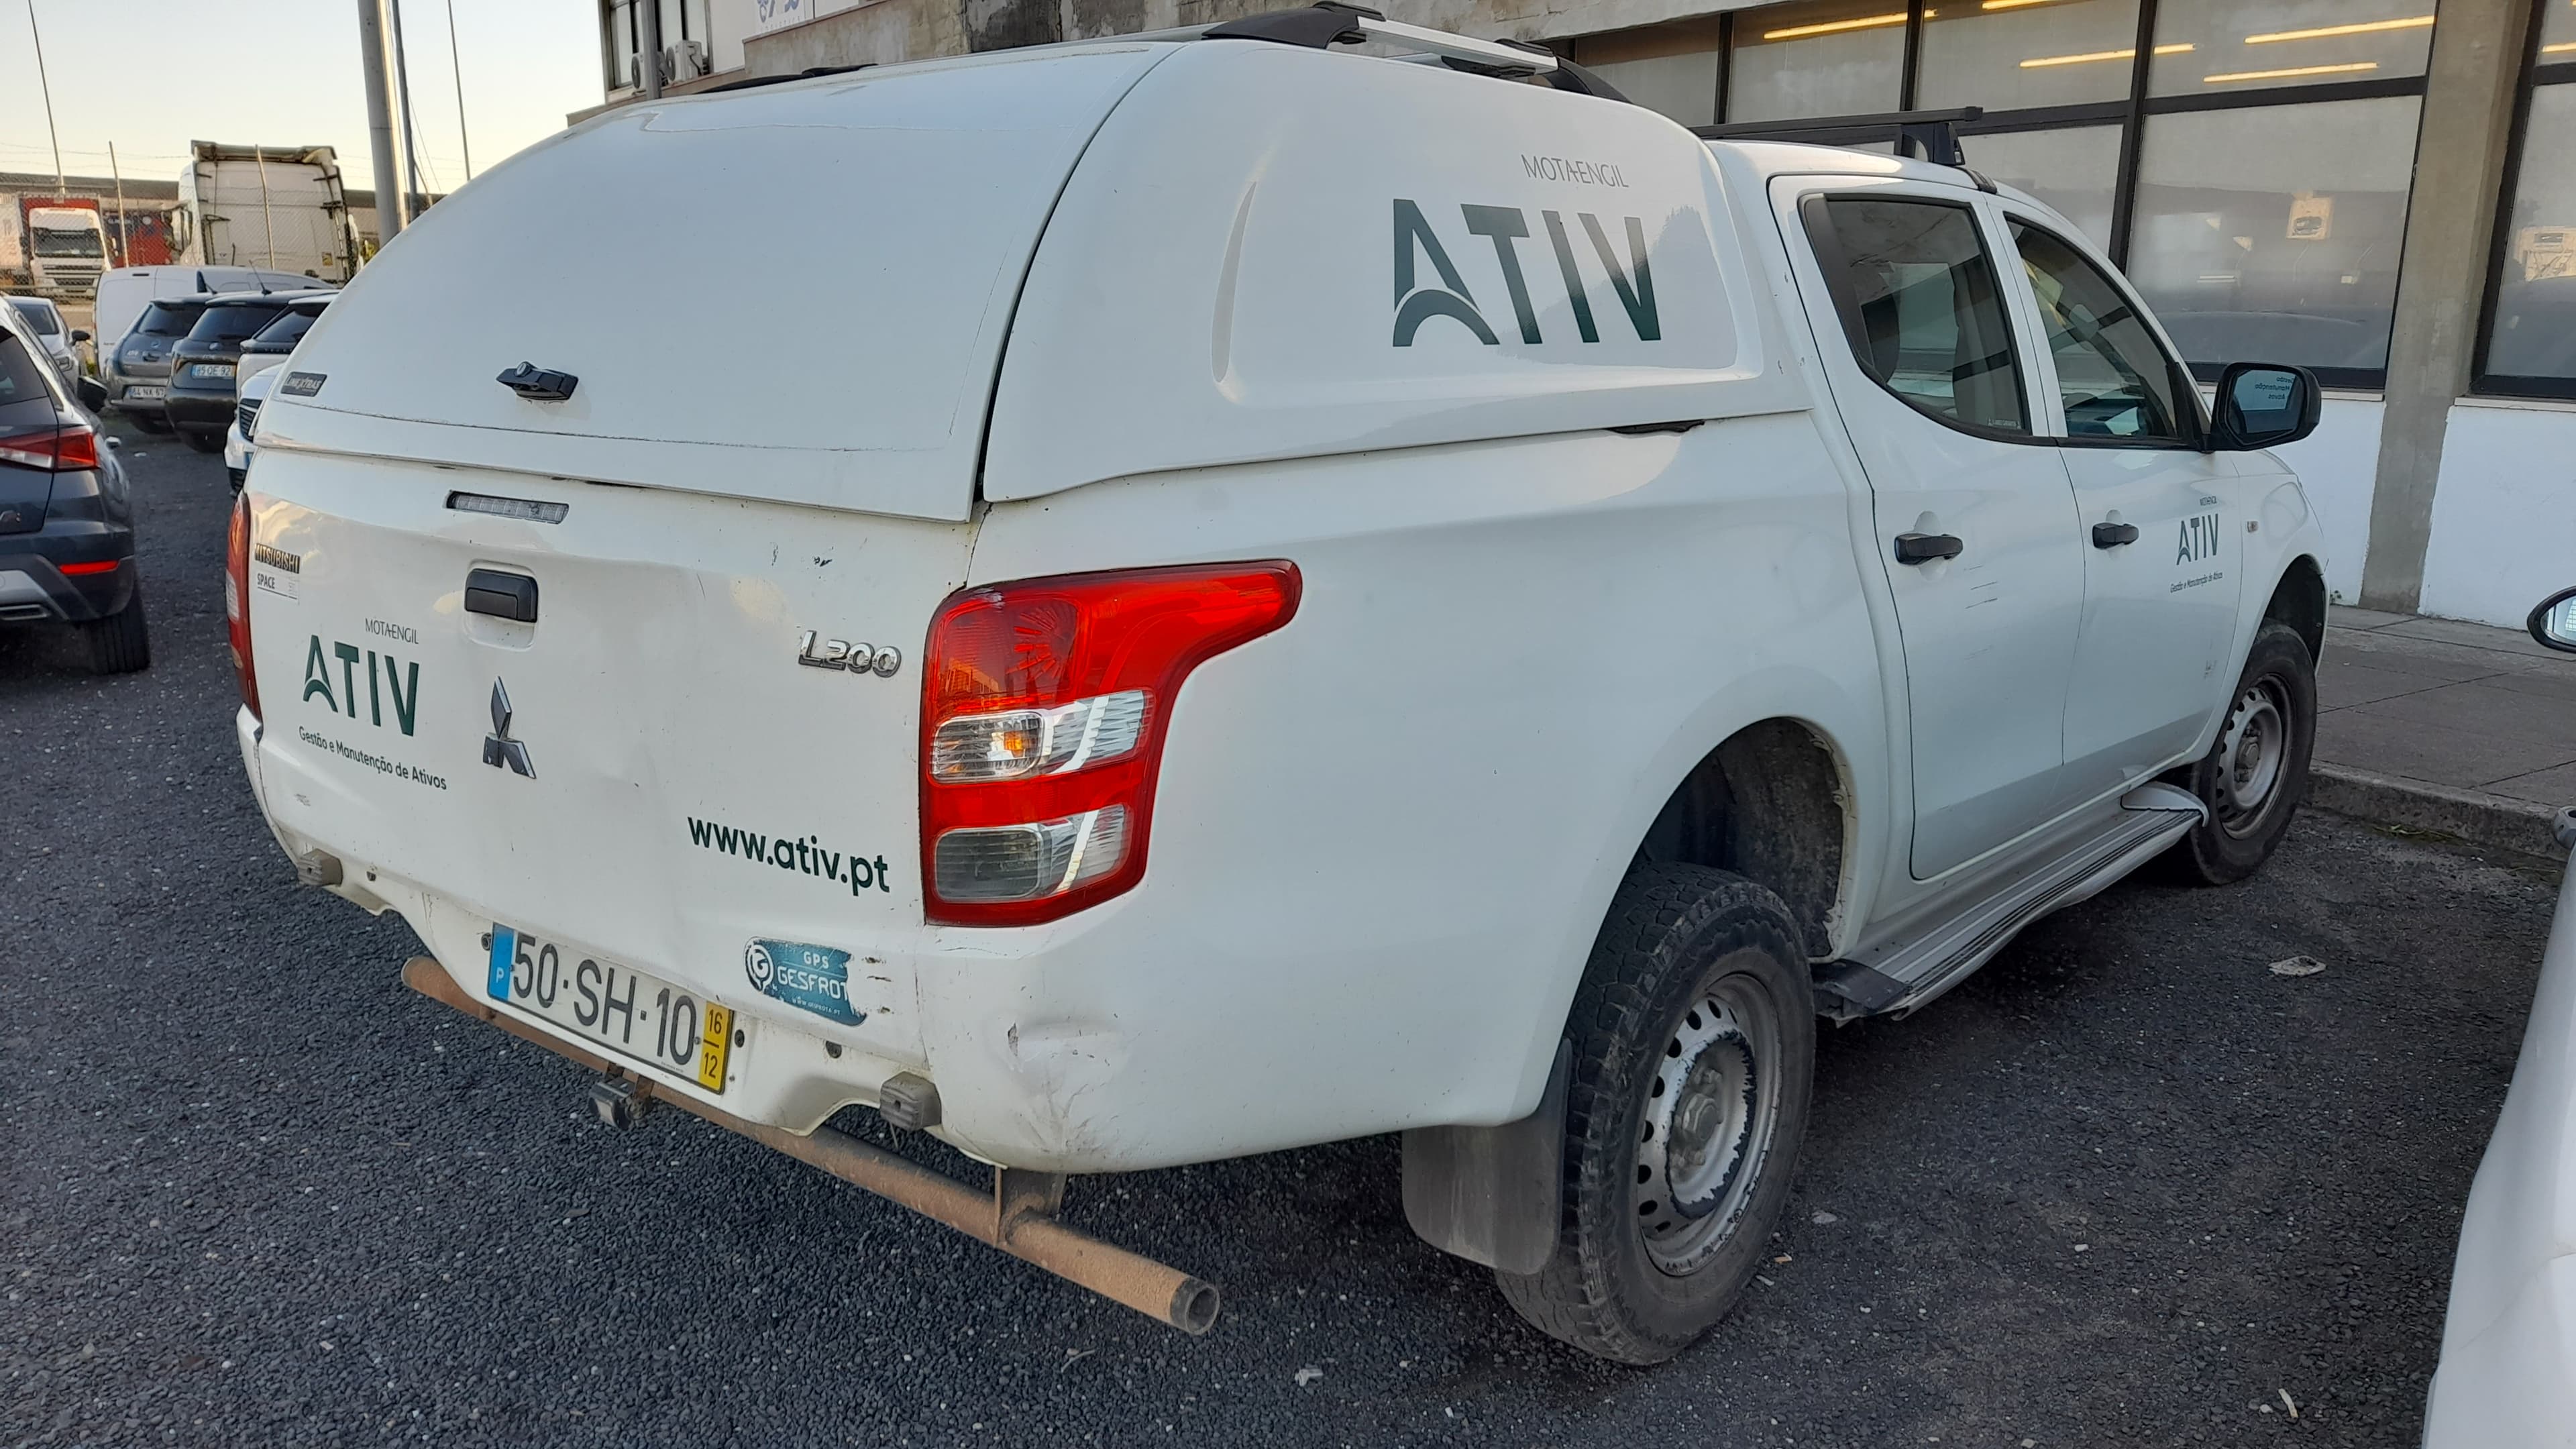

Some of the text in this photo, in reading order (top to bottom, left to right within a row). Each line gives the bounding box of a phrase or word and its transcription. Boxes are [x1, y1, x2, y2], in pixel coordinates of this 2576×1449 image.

[1392, 197, 1662, 347] ATIV
[2176, 513, 2219, 566] ATIV
[257, 572, 275, 590] SPACE
[798, 629, 902, 678] L200
[303, 634, 419, 737] ATIV
[299, 725, 447, 790] Gestão e Manutenção de Ativos
[687, 816, 890, 897] www.ativ.pt
[496, 966, 504, 983] P
[804, 951, 829, 969] GPS
[708, 1008, 723, 1034] 16
[704, 1051, 718, 1079] 12
